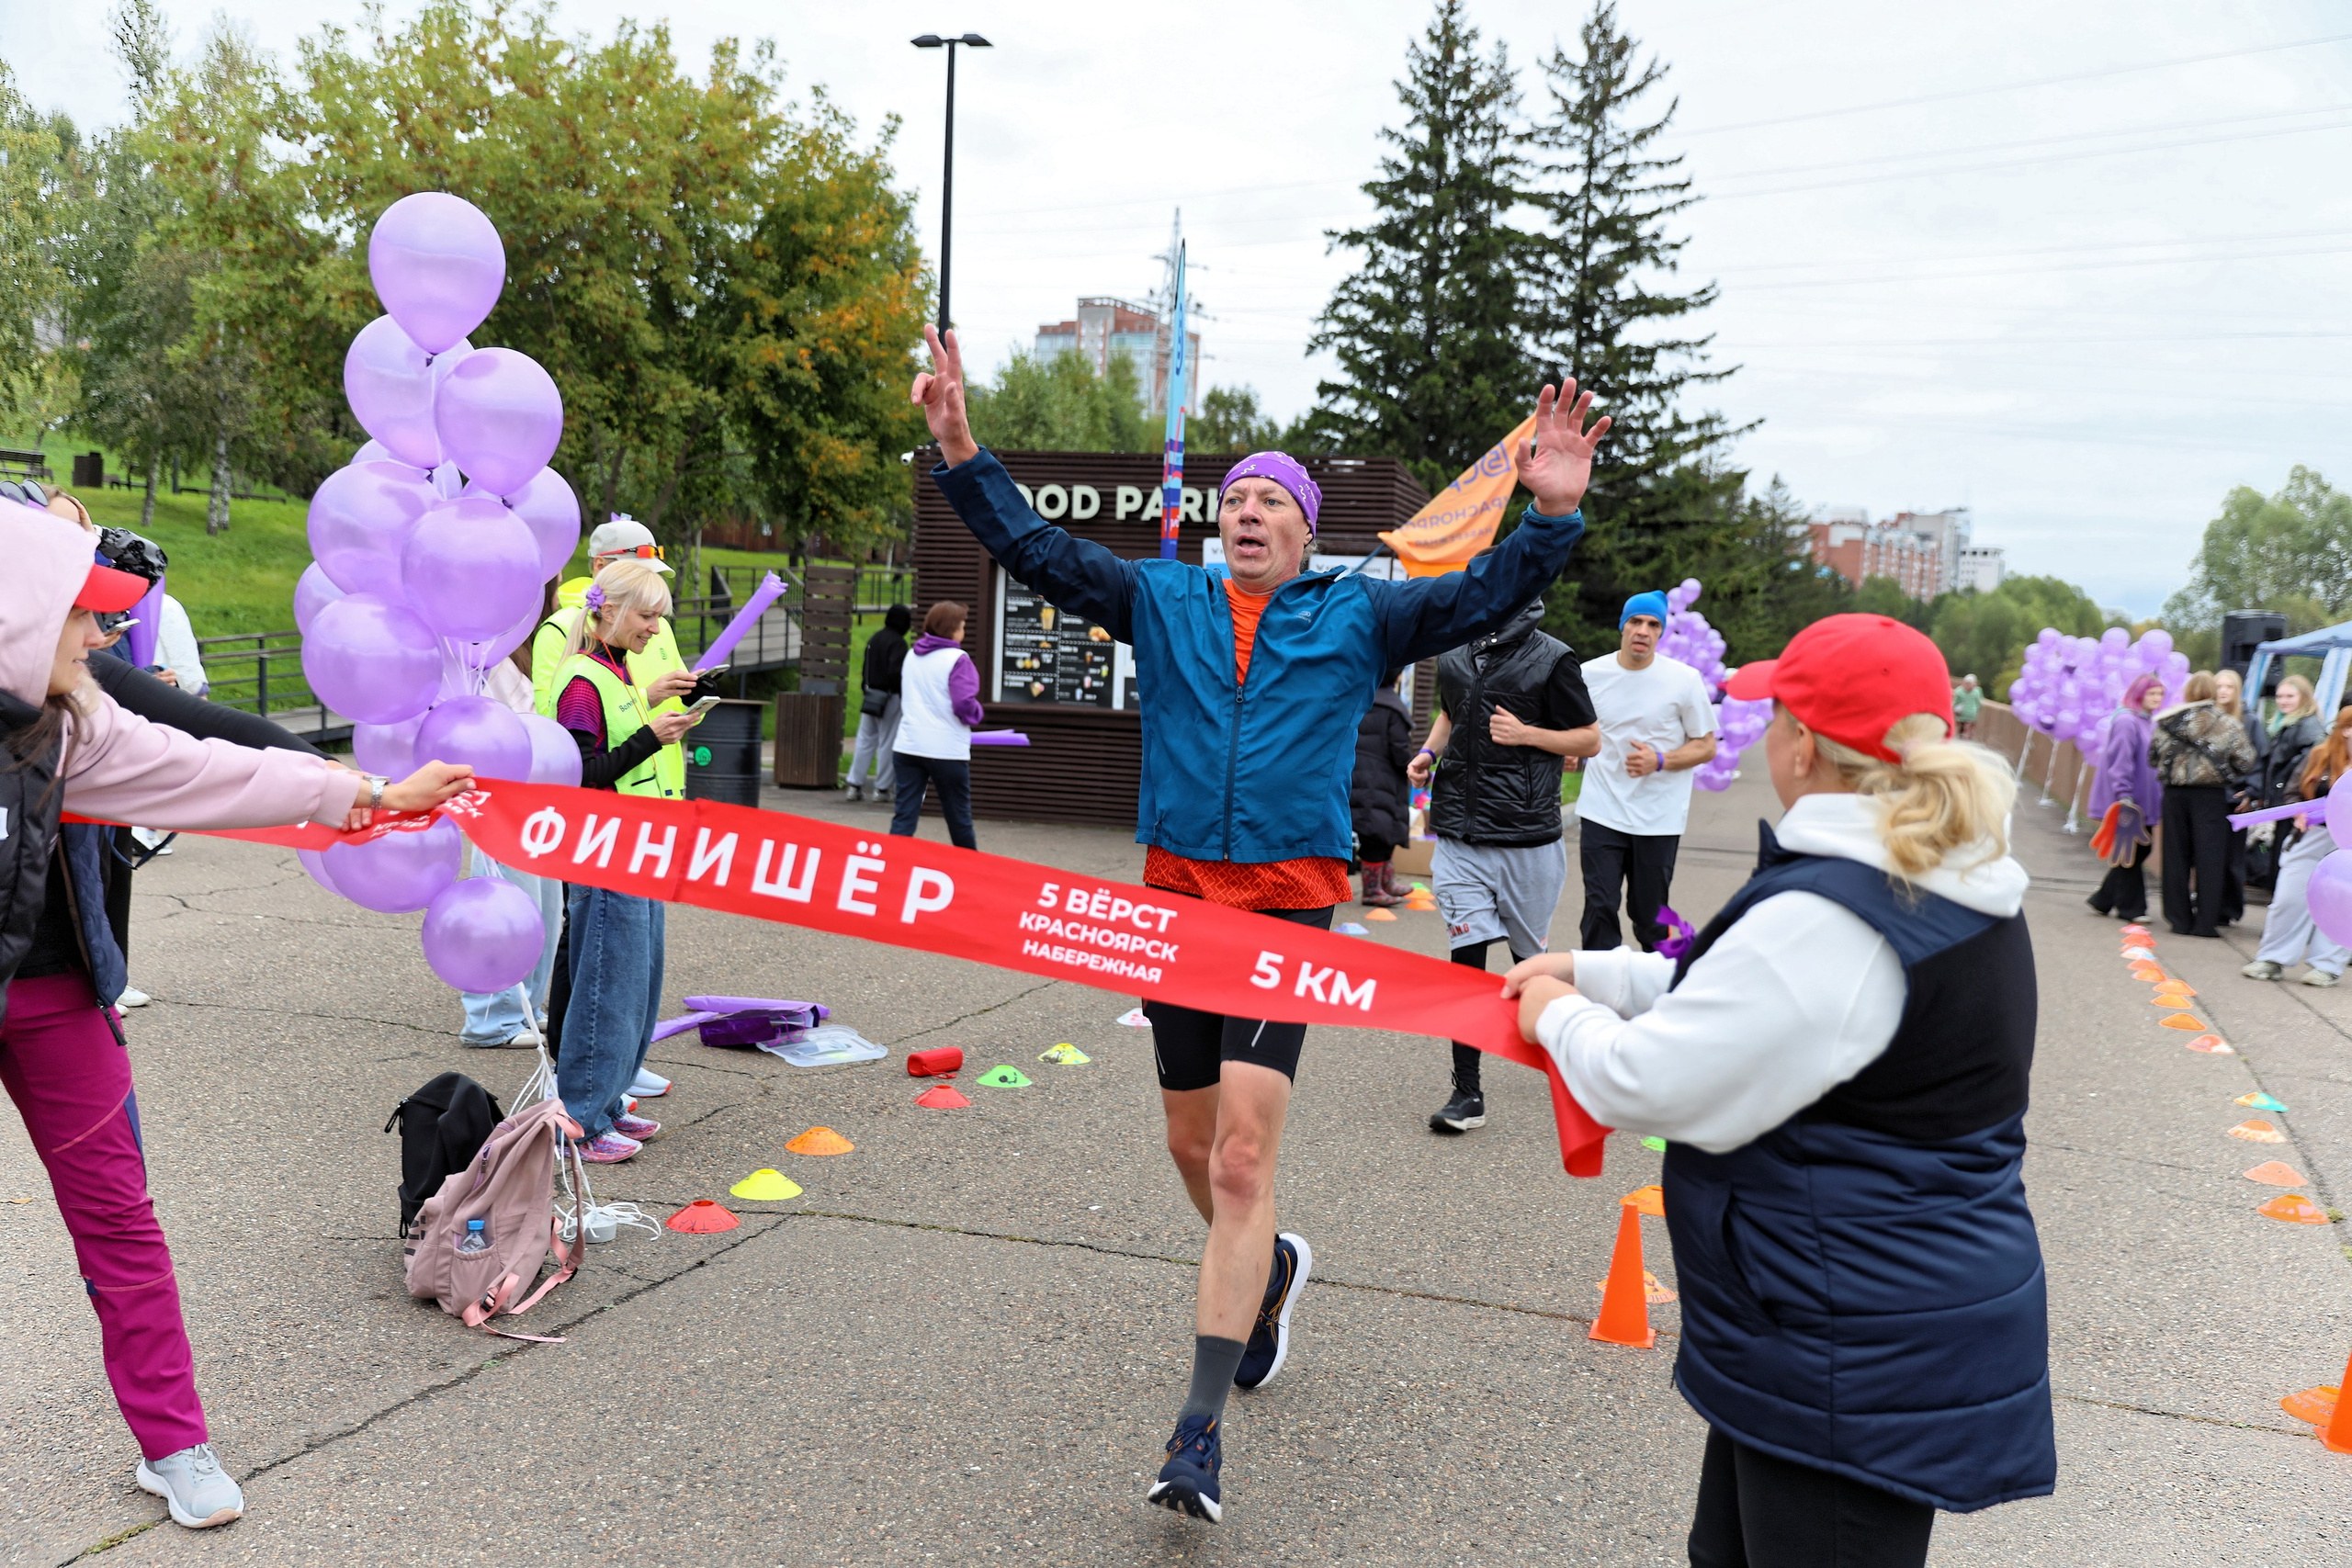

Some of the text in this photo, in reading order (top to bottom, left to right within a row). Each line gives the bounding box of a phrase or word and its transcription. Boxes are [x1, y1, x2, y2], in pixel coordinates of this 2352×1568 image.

[521, 807, 955, 924] ФИНИШЁР
[1037, 882, 1179, 933] 5 ВЁРСТ
[1019, 911, 1180, 963] КРАСНОЯРСК
[1023, 940, 1163, 984] НАБЕРЕЖНАЯ
[1250, 950, 1377, 1012] 5 КМ
